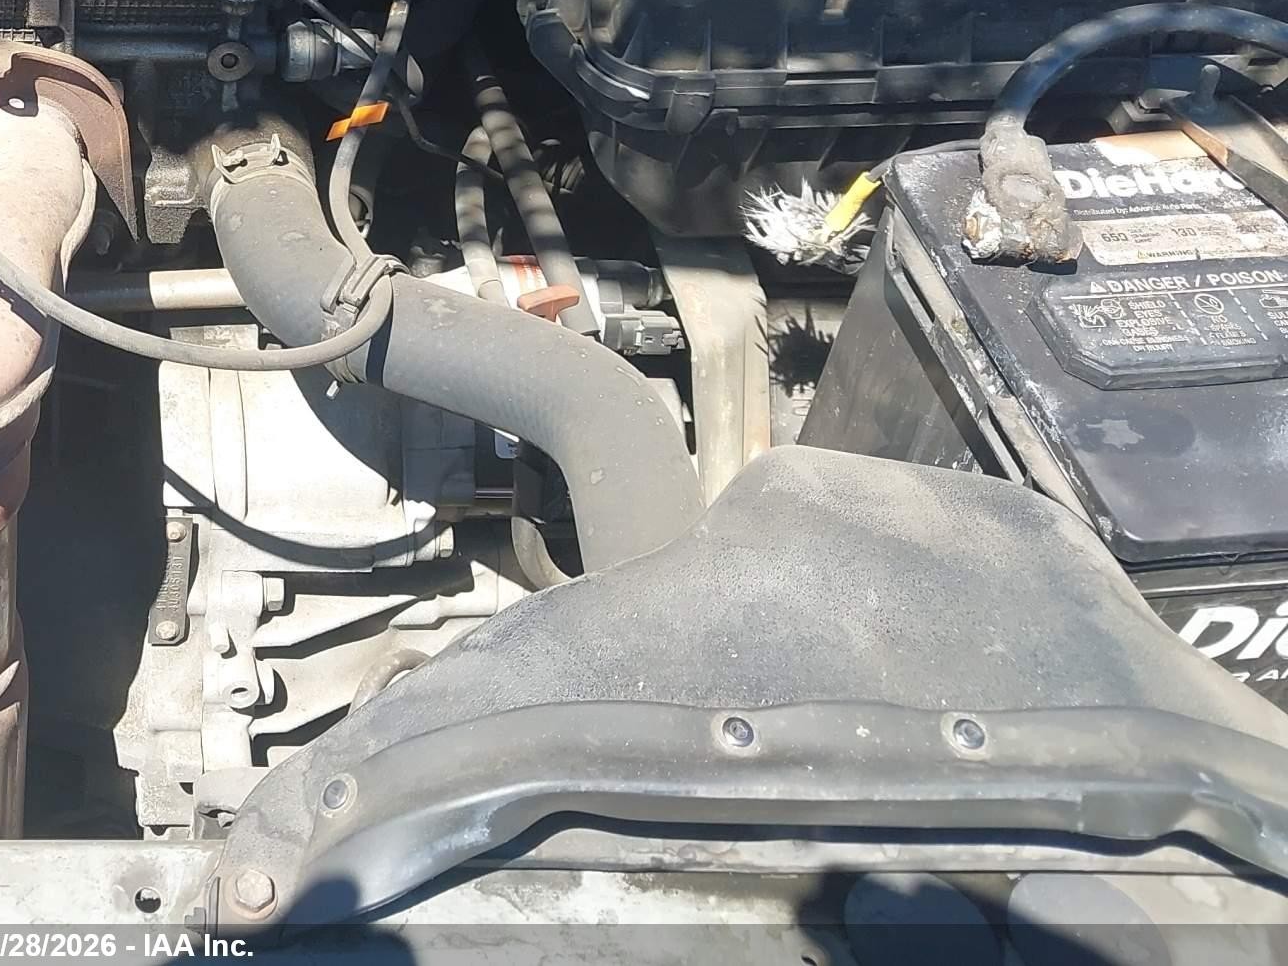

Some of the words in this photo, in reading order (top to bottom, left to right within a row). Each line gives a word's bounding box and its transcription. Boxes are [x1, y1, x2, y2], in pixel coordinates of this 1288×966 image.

[1105, 276, 1191, 293] DANGER
[1128, 300, 1166, 310] SHIELD
[1134, 309, 1163, 319] EYES
[1211, 314, 1228, 324] NO
[1115, 316, 1174, 328] EXPLOSIVE
[1122, 327, 1159, 338] GASES
